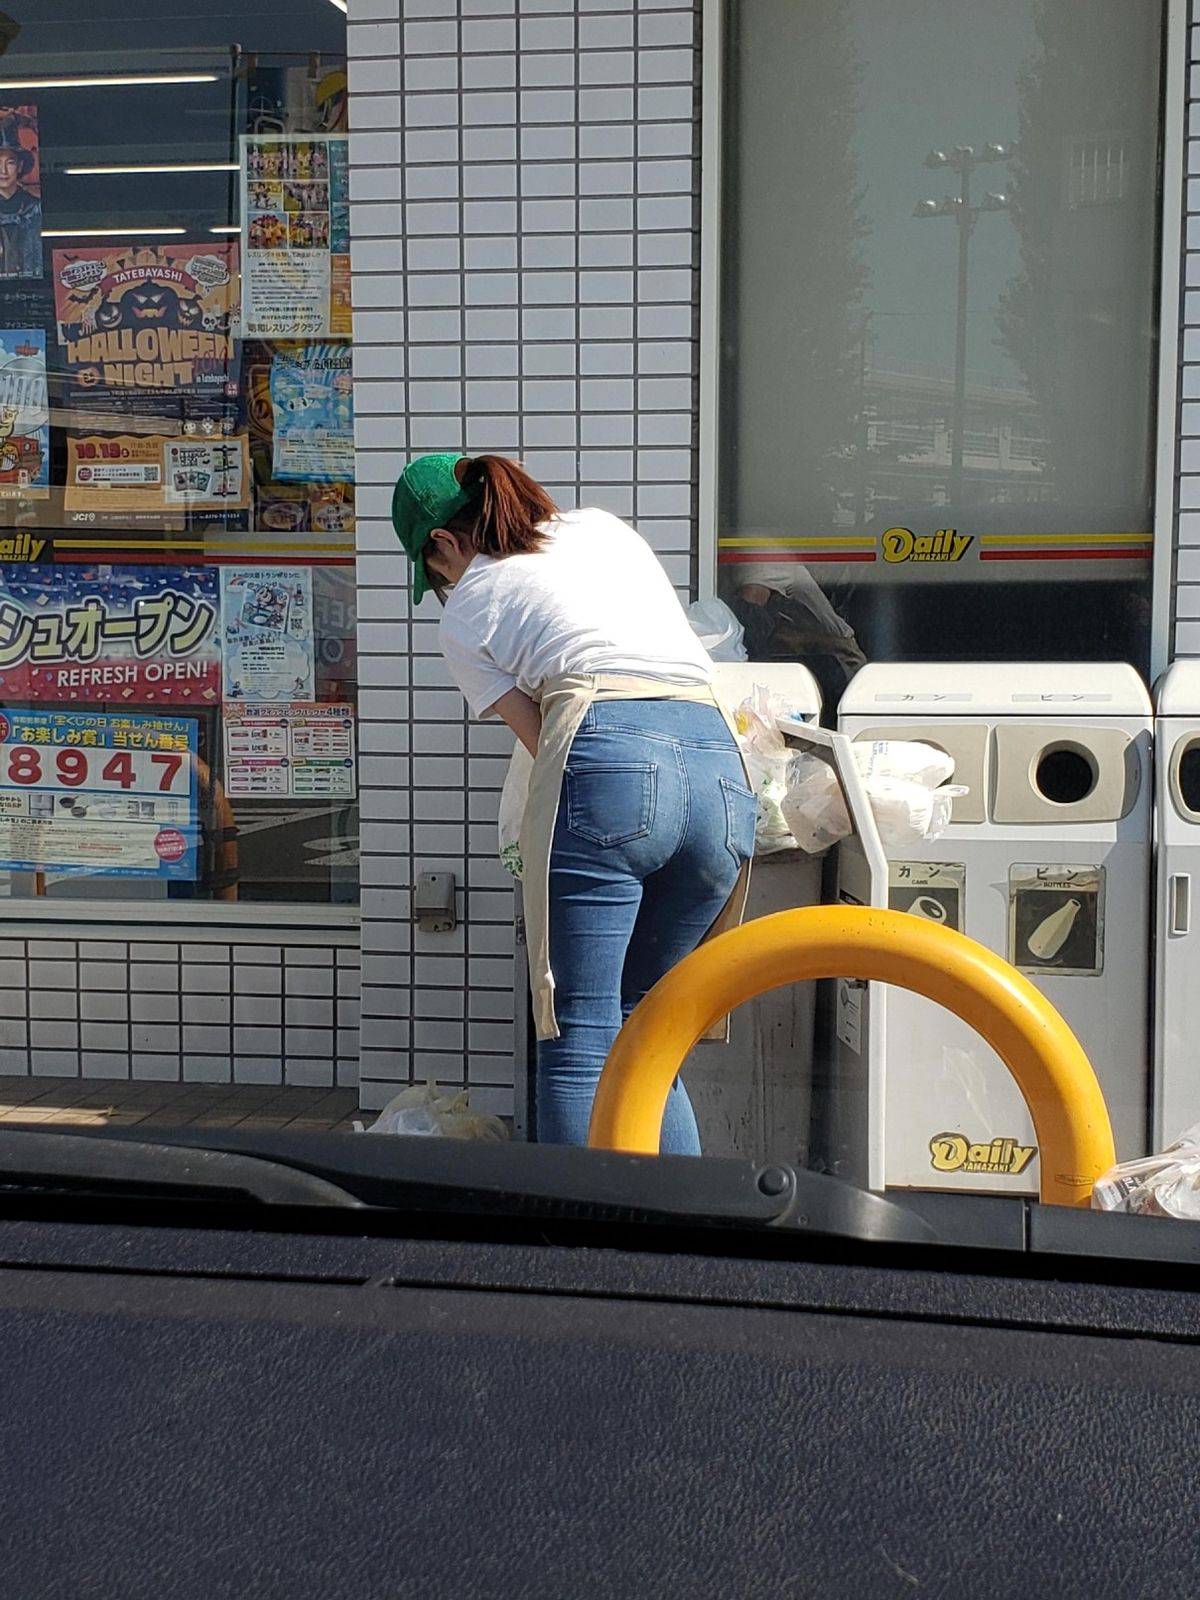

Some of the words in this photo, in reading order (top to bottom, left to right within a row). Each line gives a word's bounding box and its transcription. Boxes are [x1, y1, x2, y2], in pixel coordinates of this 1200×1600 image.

[114, 268, 183, 283] TATEBAYASHI
[67, 327, 234, 364] HALLOWEEN
[104, 361, 195, 387] NIGHT
[882, 528, 973, 562] Daily
[909, 553, 950, 561] YAMAZAKI
[57, 666, 138, 687] REFRESH
[145, 660, 208, 681] OPEN!
[901, 693, 946, 702] カン
[1040, 693, 1084, 702] ビン
[8, 746, 183, 791] 8947
[898, 866, 940, 878] カン
[1036, 868, 1079, 881] ビン
[930, 1132, 1037, 1173] Daily
[962, 1162, 1009, 1171] YAMAZAKI
